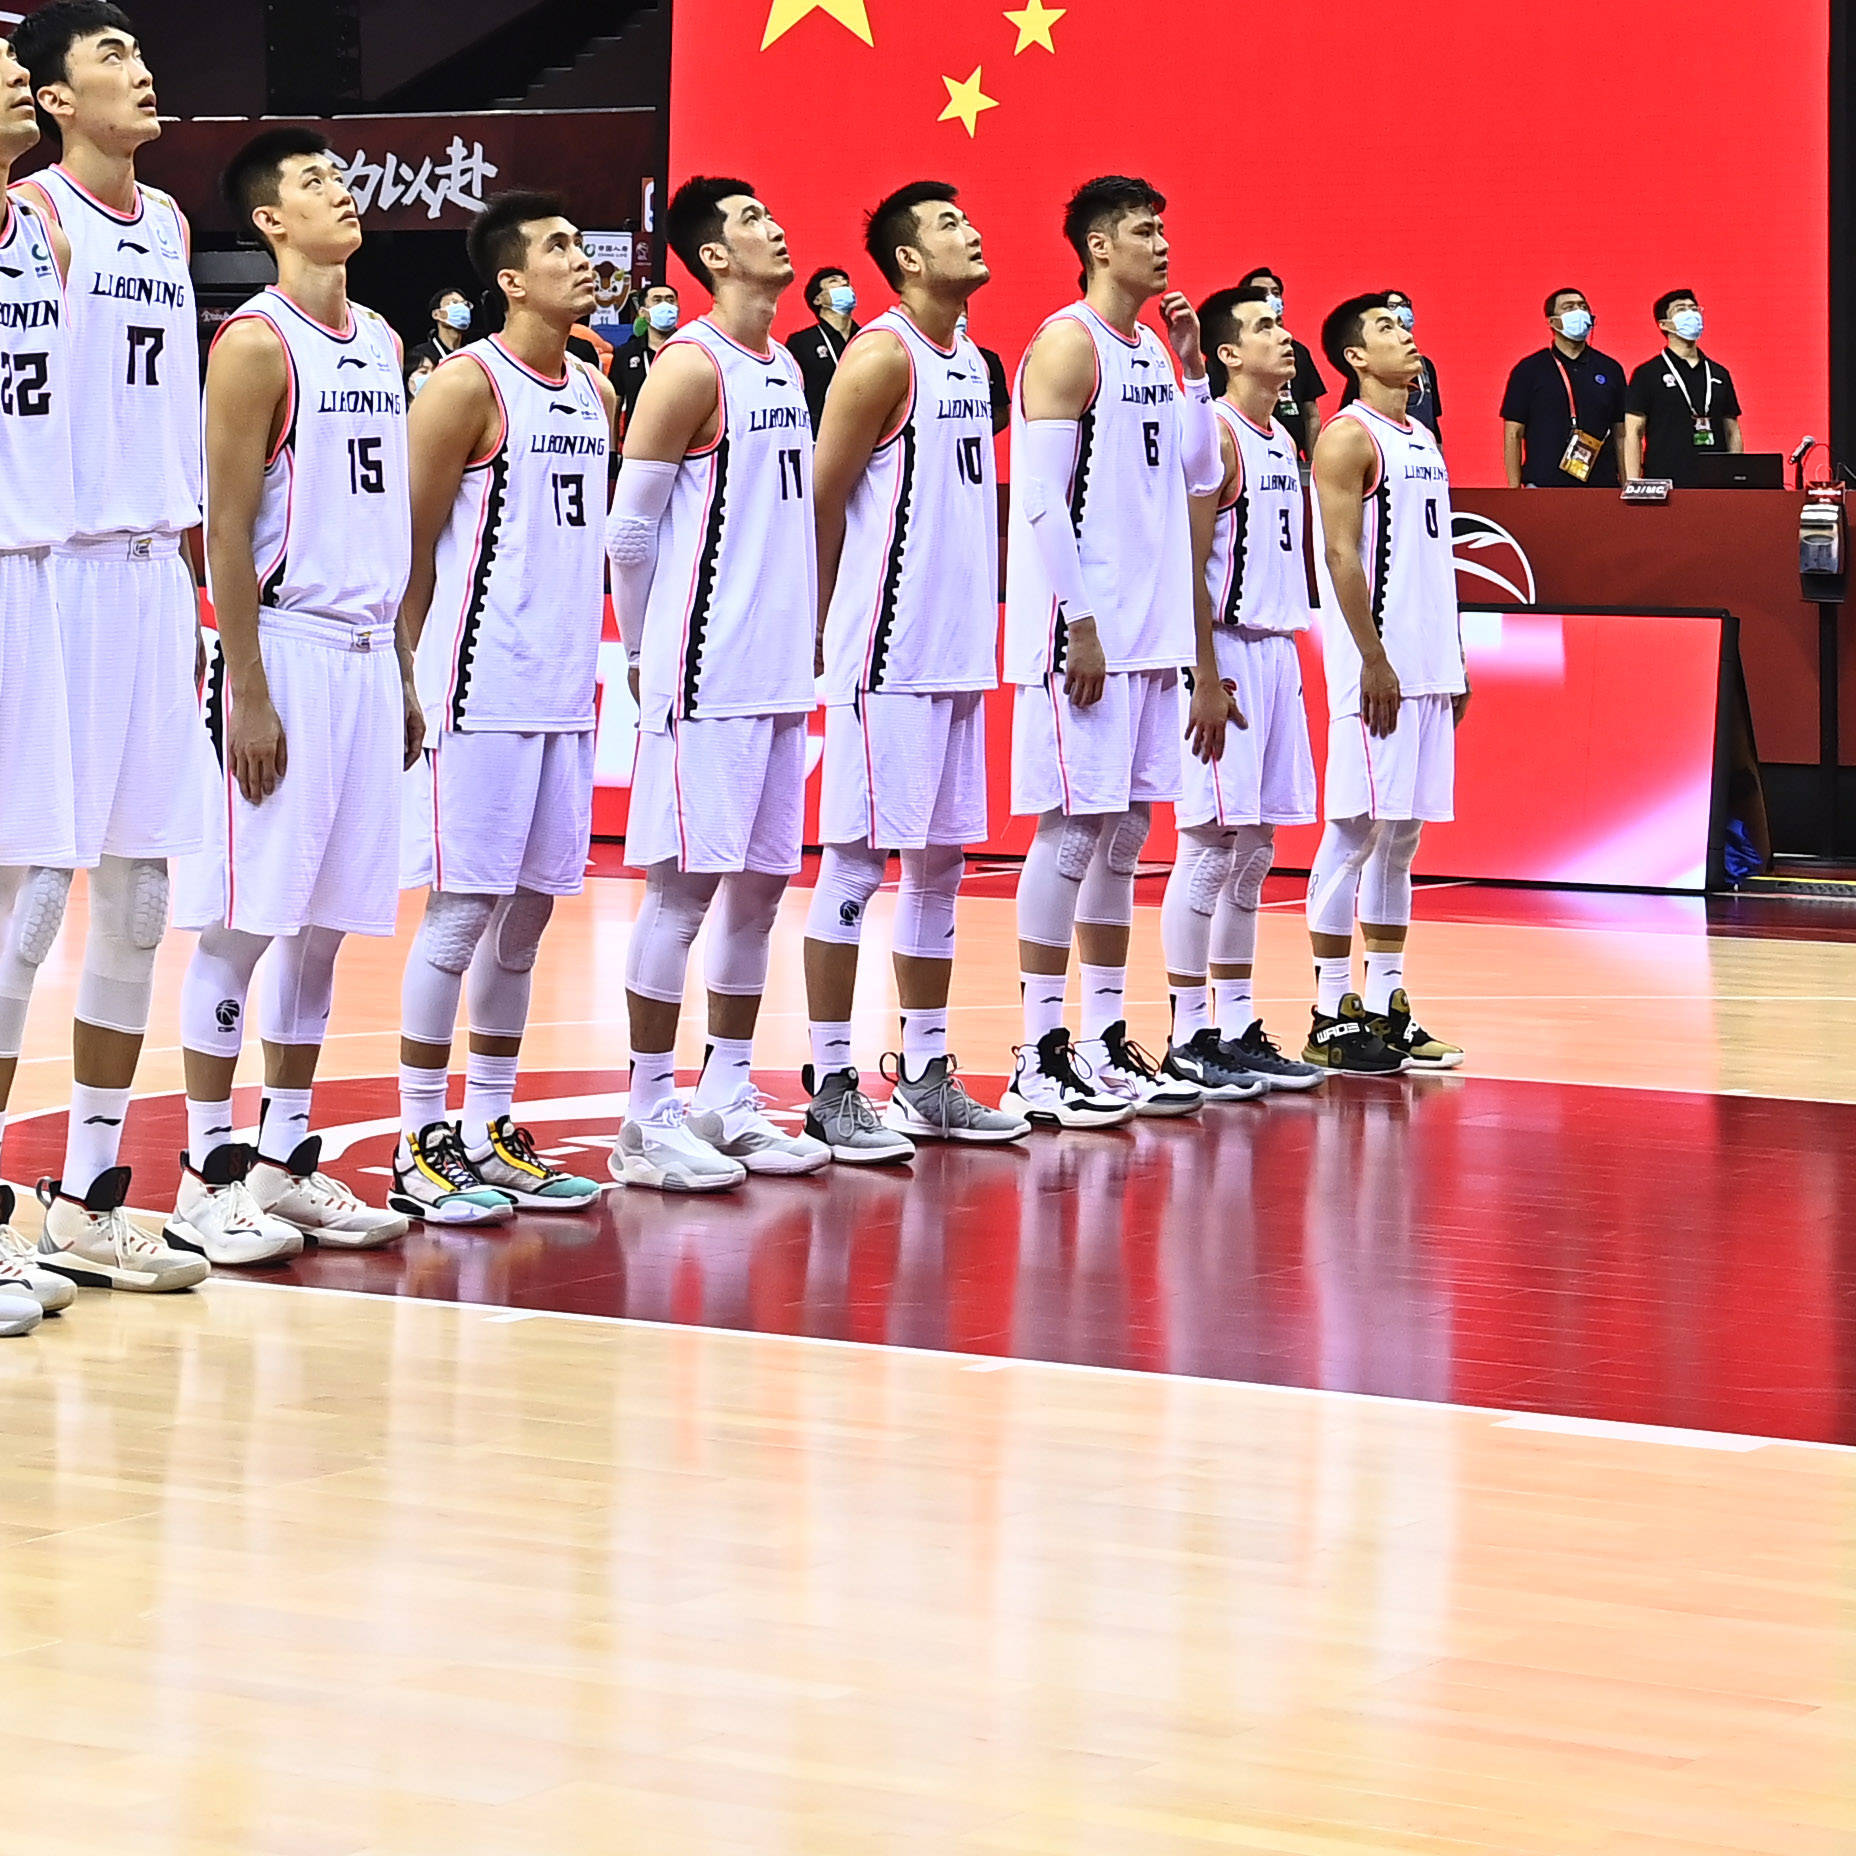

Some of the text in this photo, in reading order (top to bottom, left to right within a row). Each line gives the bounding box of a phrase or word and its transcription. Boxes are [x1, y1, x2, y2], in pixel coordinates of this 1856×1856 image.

[92, 270, 186, 312] LIAONING
[126, 325, 166, 386] 17
[0, 351, 52, 417] 22
[317, 390, 401, 417] LIAONING
[347, 436, 386, 494] 15
[531, 433, 606, 458] LIAONING
[956, 436, 983, 485] 10
[1142, 421, 1160, 467] 6
[778, 448, 803, 501] 11
[552, 472, 587, 527] 13
[1425, 498, 1439, 538] 0
[1279, 508, 1293, 552] 3
